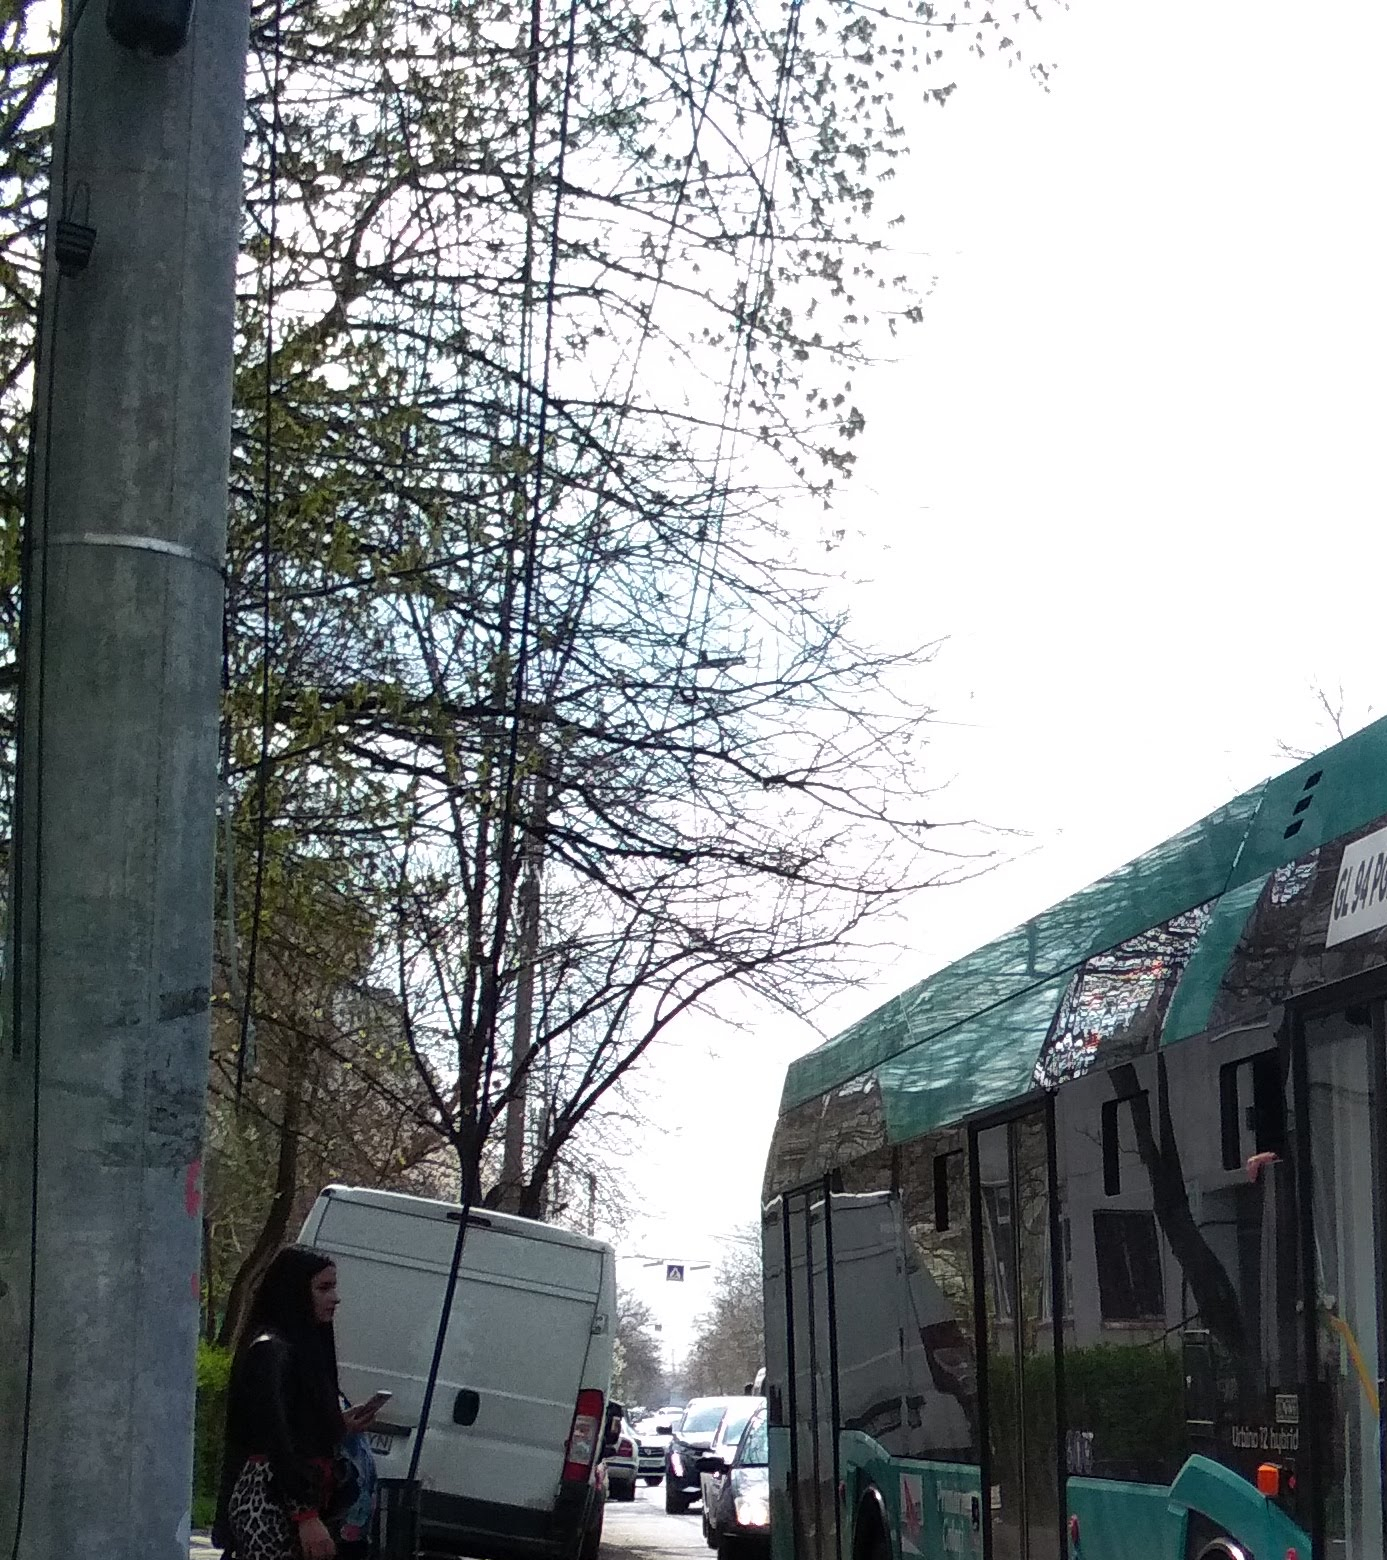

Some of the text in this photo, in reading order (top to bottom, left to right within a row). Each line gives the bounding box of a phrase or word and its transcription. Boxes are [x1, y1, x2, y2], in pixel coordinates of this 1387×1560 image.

[1334, 865, 1354, 921] GL
[1351, 856, 1374, 914] 94
[1232, 1426, 1259, 1448] Urbino
[1270, 1427, 1299, 1455] hybrid
